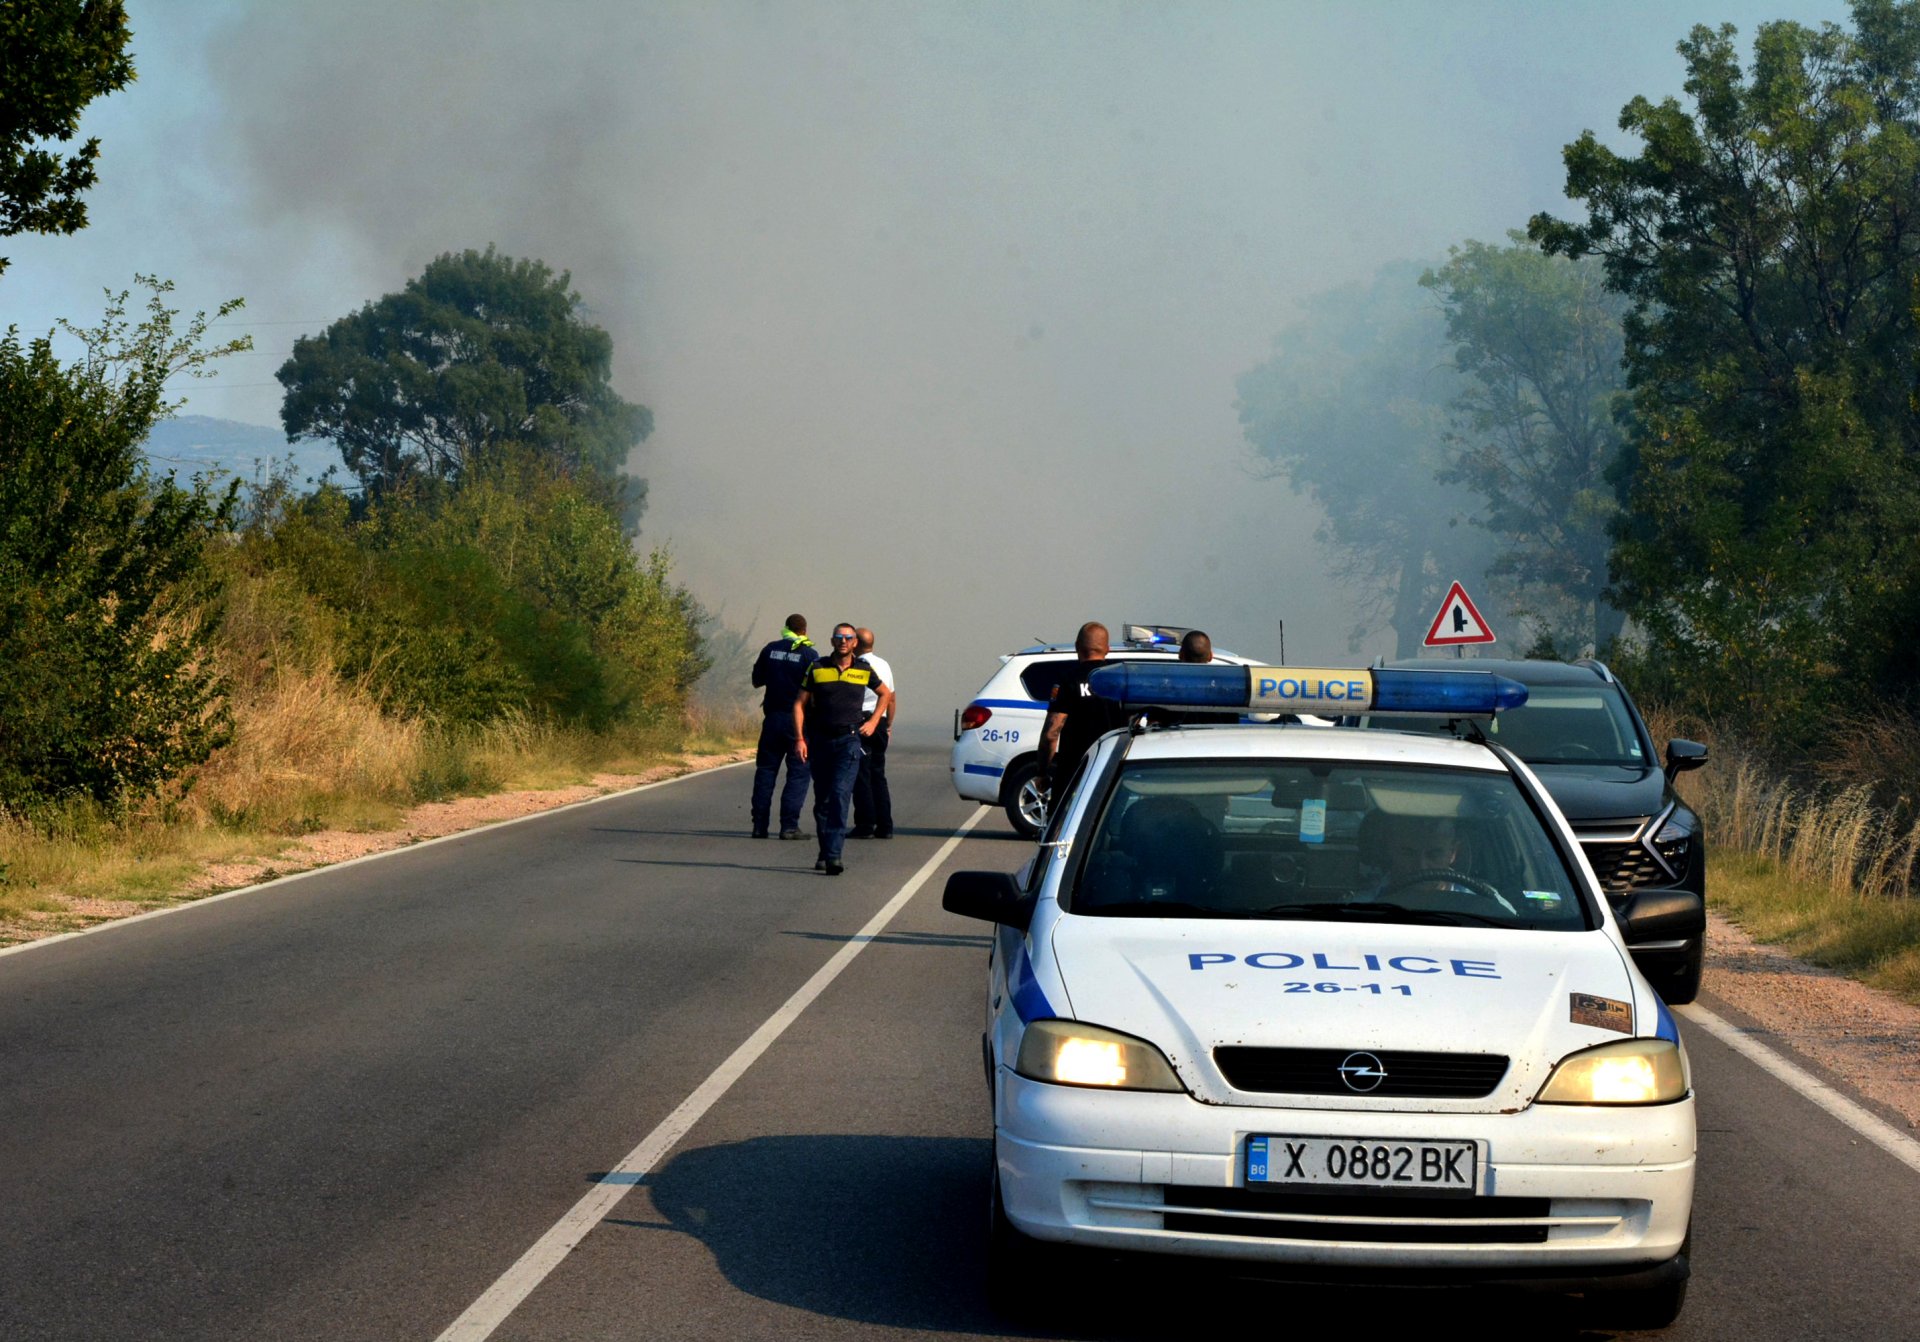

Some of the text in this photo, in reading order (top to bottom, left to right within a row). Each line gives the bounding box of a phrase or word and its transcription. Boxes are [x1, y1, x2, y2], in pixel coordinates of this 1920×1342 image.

[1259, 678, 1365, 700] POLICE
[982, 728, 1020, 743] 26-19
[1188, 952, 1503, 980] POLICE
[1282, 982, 1413, 997] 26-11
[1250, 1164, 1266, 1176] BG
